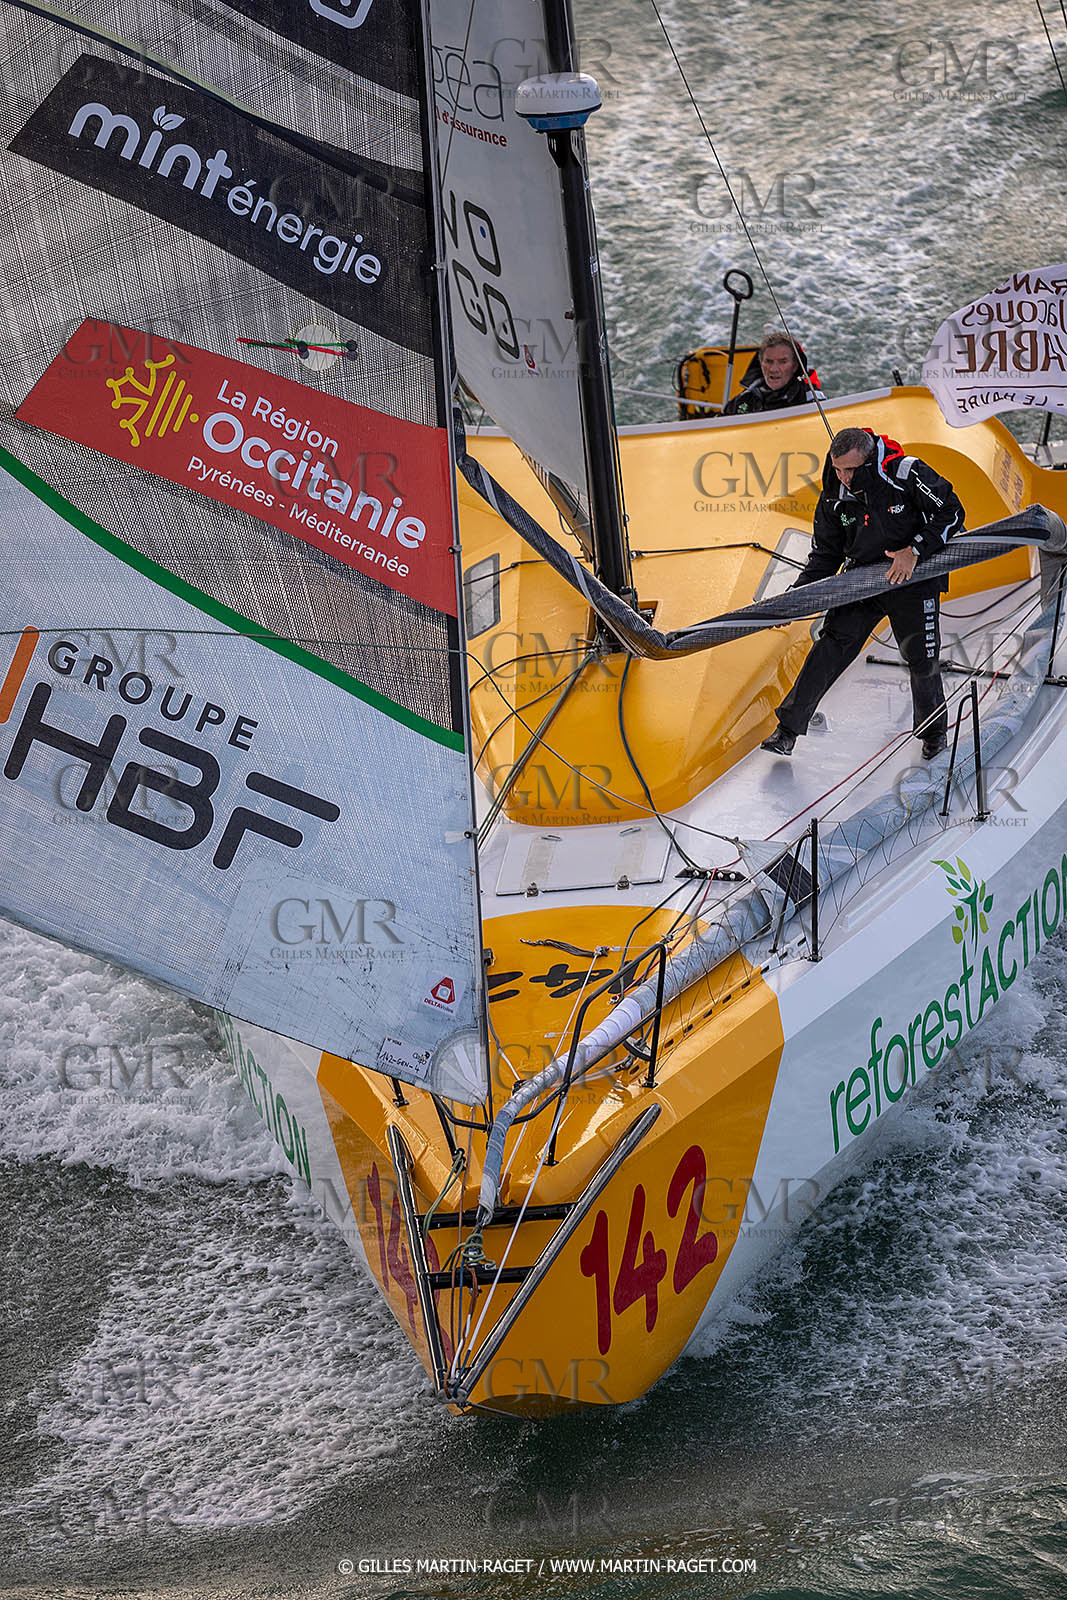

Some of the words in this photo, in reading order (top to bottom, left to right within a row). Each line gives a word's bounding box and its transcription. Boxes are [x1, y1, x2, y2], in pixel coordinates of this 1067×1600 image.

[68, 102, 232, 199] mint
[227, 179, 382, 285] énergie
[216, 378, 247, 410] La
[251, 396, 340, 458] Région
[186, 456, 276, 509] Pyrénées
[288, 502, 410, 578] Méditerranée
[202, 411, 428, 550] Occitanie
[48, 640, 259, 752] GROUPE
[3, 681, 341, 871] HBF
[580, 1144, 718, 1355] 142
